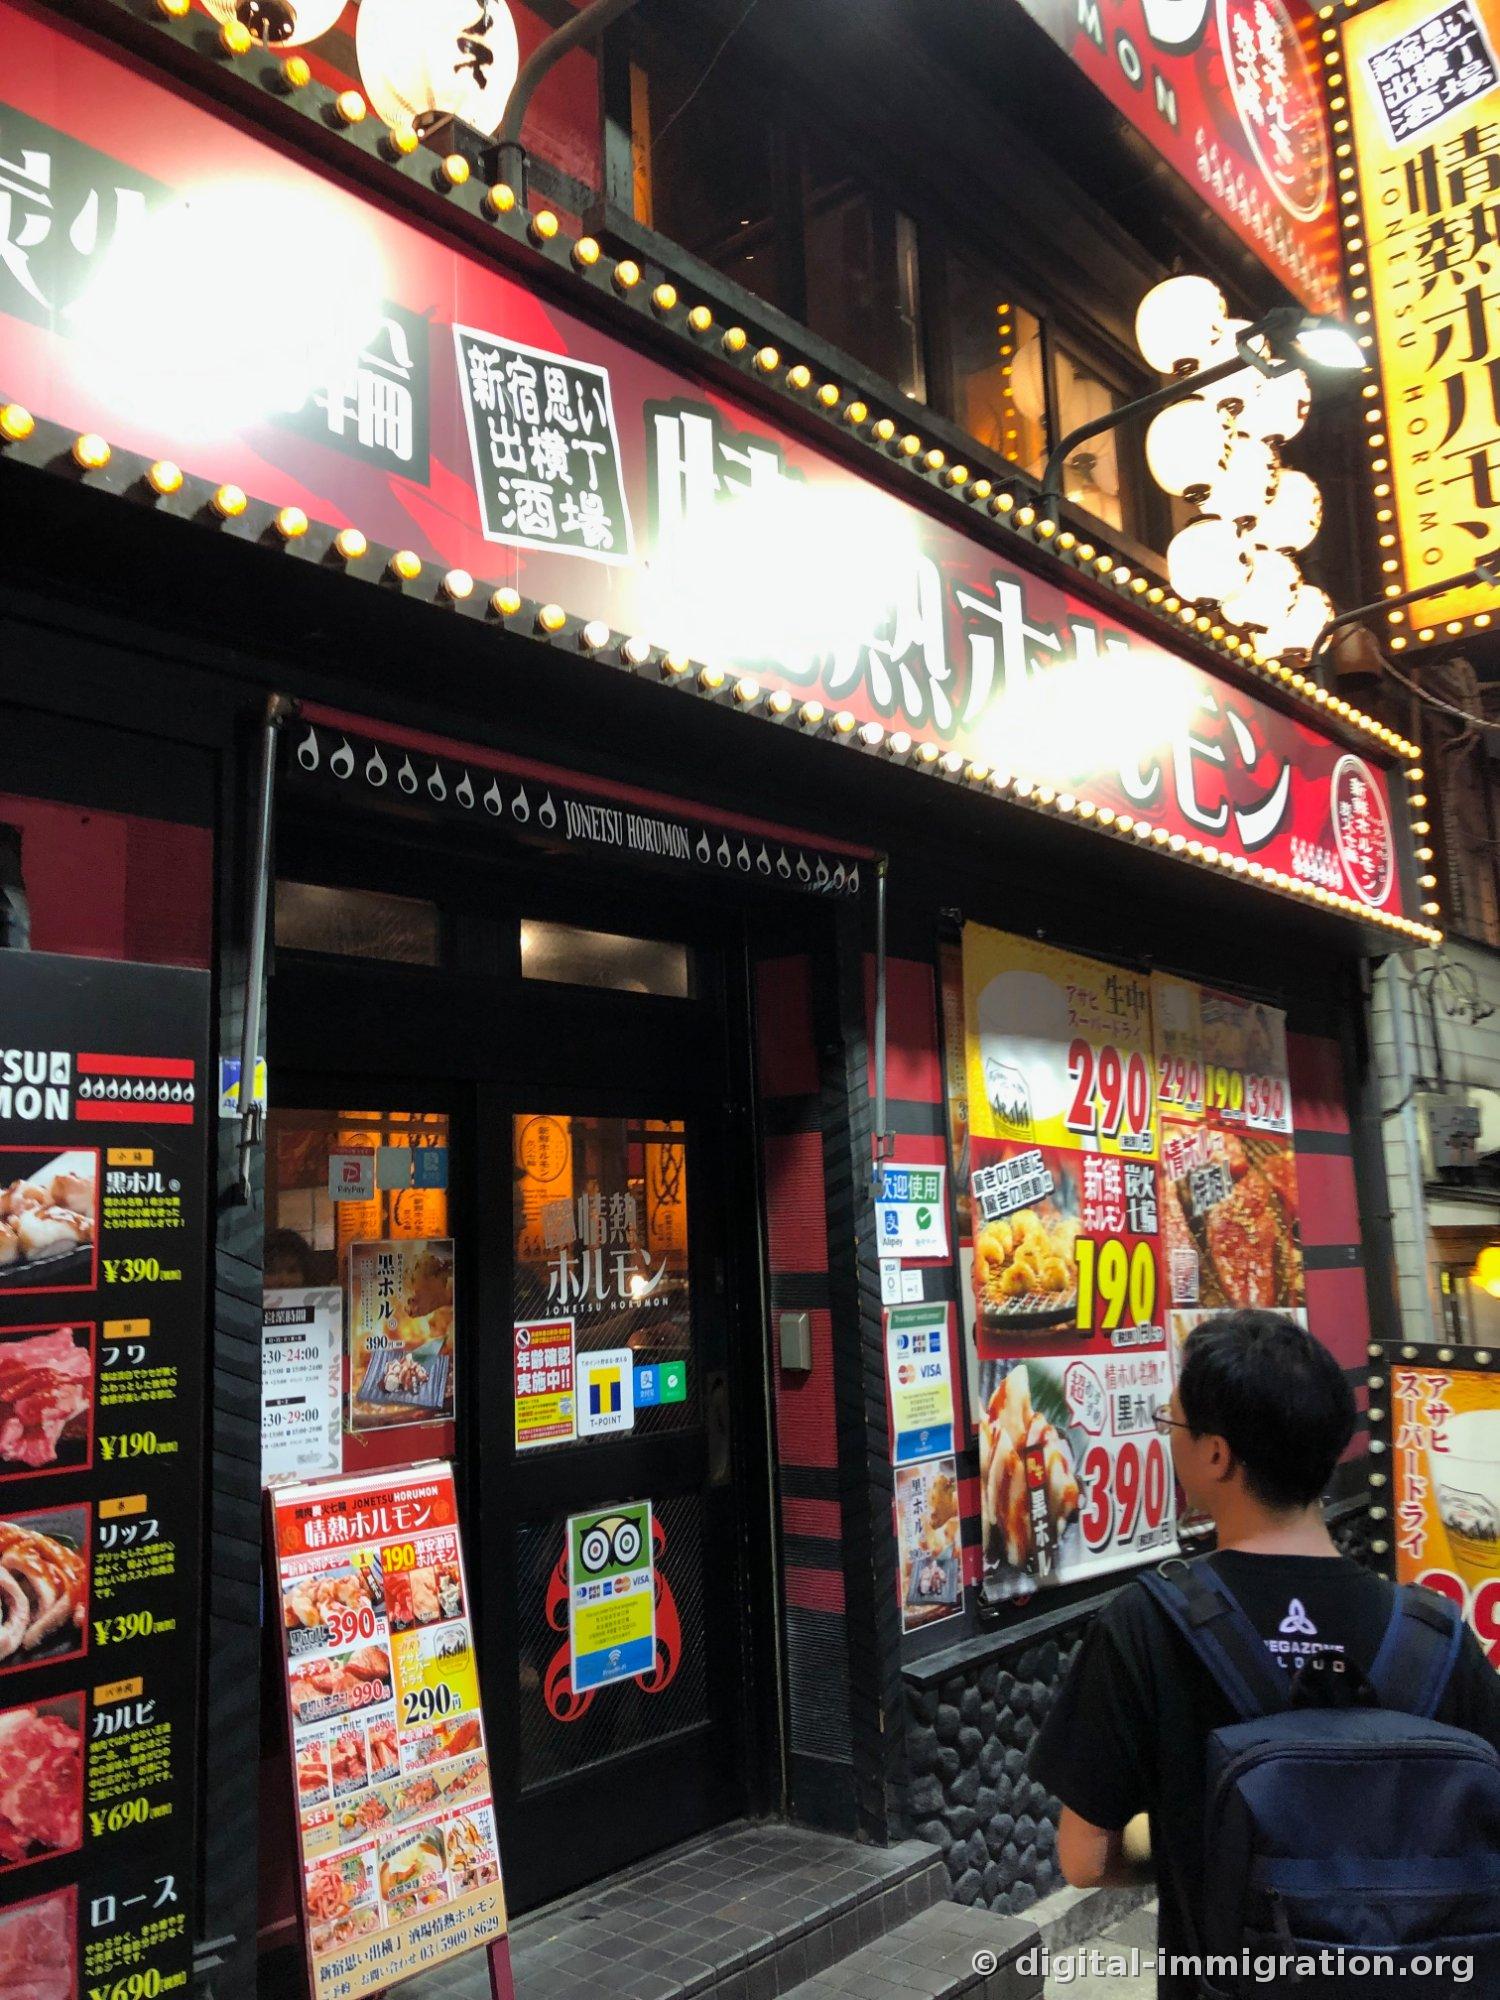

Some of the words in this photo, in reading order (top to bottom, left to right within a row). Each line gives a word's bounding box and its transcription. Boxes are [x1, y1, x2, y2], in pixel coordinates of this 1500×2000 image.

[467, 344, 606, 435] 新宿思い
[487, 416, 607, 491] 出横丁
[497, 476, 615, 550] 酒場
[564, 800, 624, 846] JONETSU
[627, 815, 691, 860] HORUMON
[0, 1049, 48, 1085] SU
[1066, 1037, 1150, 1136] 290
[1158, 1053, 1199, 1104] 290
[1205, 1064, 1244, 1111] 190
[1248, 1074, 1285, 1121] 390
[106, 1171, 166, 1194] 黒ホル
[337, 1184, 366, 1195] PayPay
[577, 1191, 638, 1246] 情熱
[102, 1258, 160, 1284] ¥390
[377, 1253, 395, 1321] 黒ホル
[546, 1248, 667, 1305] ホルモン
[1074, 1237, 1157, 1331] 190
[545, 1304, 602, 1316] JONETSU
[610, 1297, 669, 1311] HORUMON
[101, 1344, 146, 1367] フワ
[516, 1346, 571, 1371] 年齢確認
[920, 1363, 943, 1379] VISA
[590, 1414, 623, 1428] T-POINT
[1425, 1374, 1451, 1454] アサヒ
[98, 1430, 157, 1461] ¥190
[1081, 1437, 1166, 1546] 390
[303, 1502, 432, 1548] 情熱ホルモン
[383, 1543, 416, 1573] 190
[632, 1572, 650, 1587] VISA
[92, 1610, 154, 1646] ¥390
[91, 1698, 157, 1738] カルビ
[88, 1797, 150, 1837] ¥690
[306, 1807, 330, 1827] SET
[90, 1874, 178, 1928] ロース
